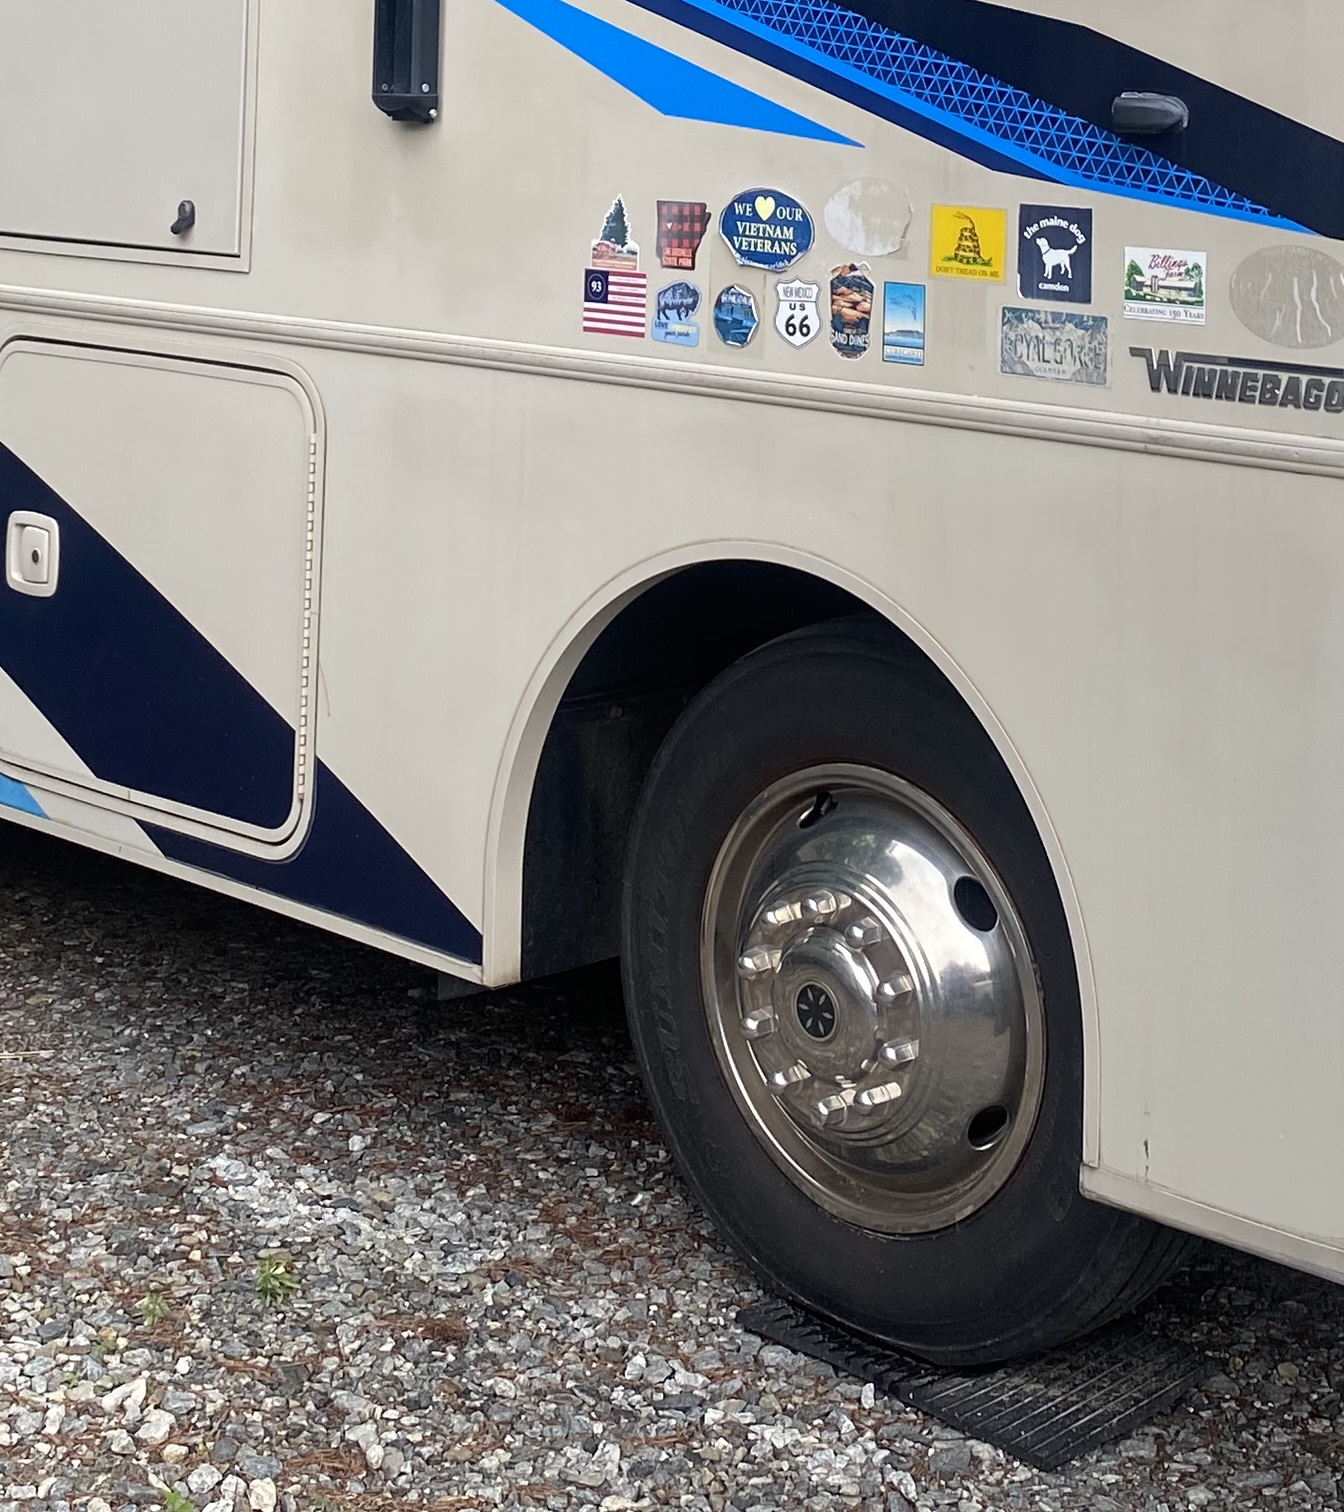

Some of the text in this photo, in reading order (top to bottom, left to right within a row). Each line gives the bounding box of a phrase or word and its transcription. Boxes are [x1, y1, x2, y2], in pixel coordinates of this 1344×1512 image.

[733, 202, 804, 222] WE OUR
[736, 221, 794, 240] VIETNAM
[1023, 215, 1087, 245] the maine dog
[733, 236, 797, 256] VETERANS
[1148, 254, 1189, 271] Billings
[935, 266, 955, 275] DON'T
[956, 267, 977, 276] TREAD
[989, 270, 999, 278] ME
[591, 280, 602, 292] 93
[782, 286, 813, 299] NEW MEXICO
[1038, 282, 1069, 292] camden
[654, 320, 668, 329] LOVE
[785, 314, 811, 337] 66
[831, 330, 848, 345] SAND
[848, 333, 870, 348] DUNES
